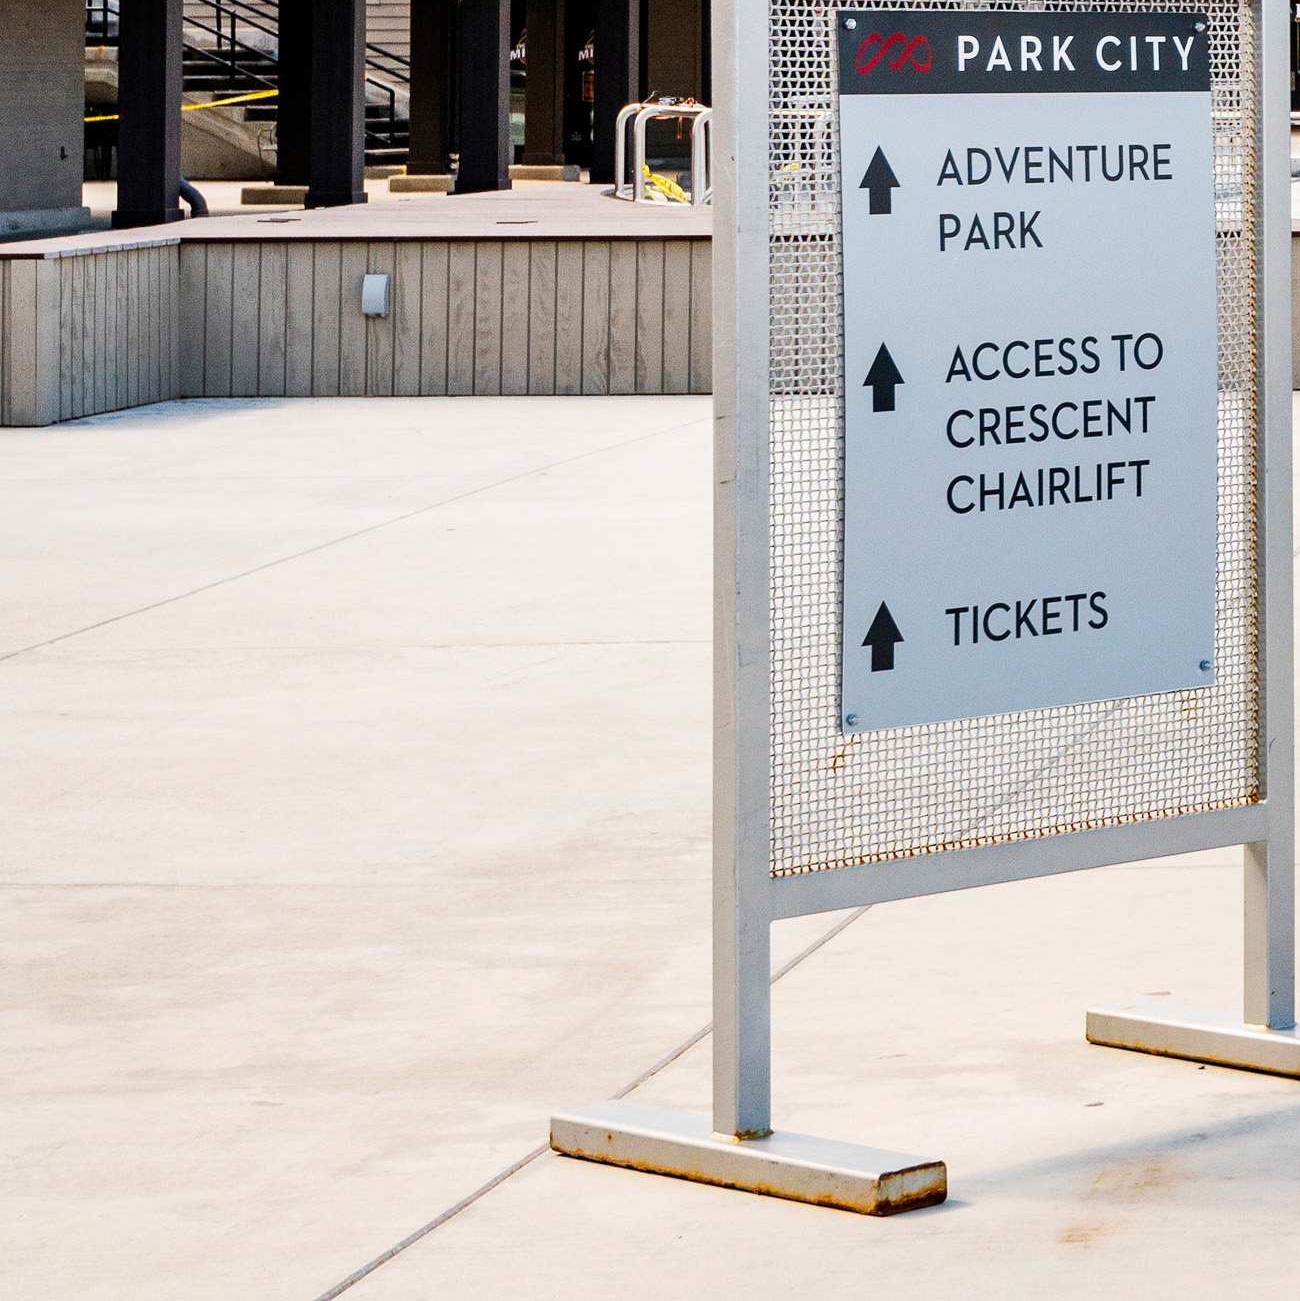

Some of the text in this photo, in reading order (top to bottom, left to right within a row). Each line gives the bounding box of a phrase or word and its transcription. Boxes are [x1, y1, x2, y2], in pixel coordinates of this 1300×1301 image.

[957, 35, 1195, 72] PARK CITY
[937, 144, 1173, 186] ADVENTURE
[940, 211, 1043, 251] PARK
[946, 332, 1164, 384] ACCESS TO
[946, 396, 1156, 449] CRESCENT
[946, 460, 1150, 515] CHAIRLIFT
[945, 591, 1109, 647] TICKETS
